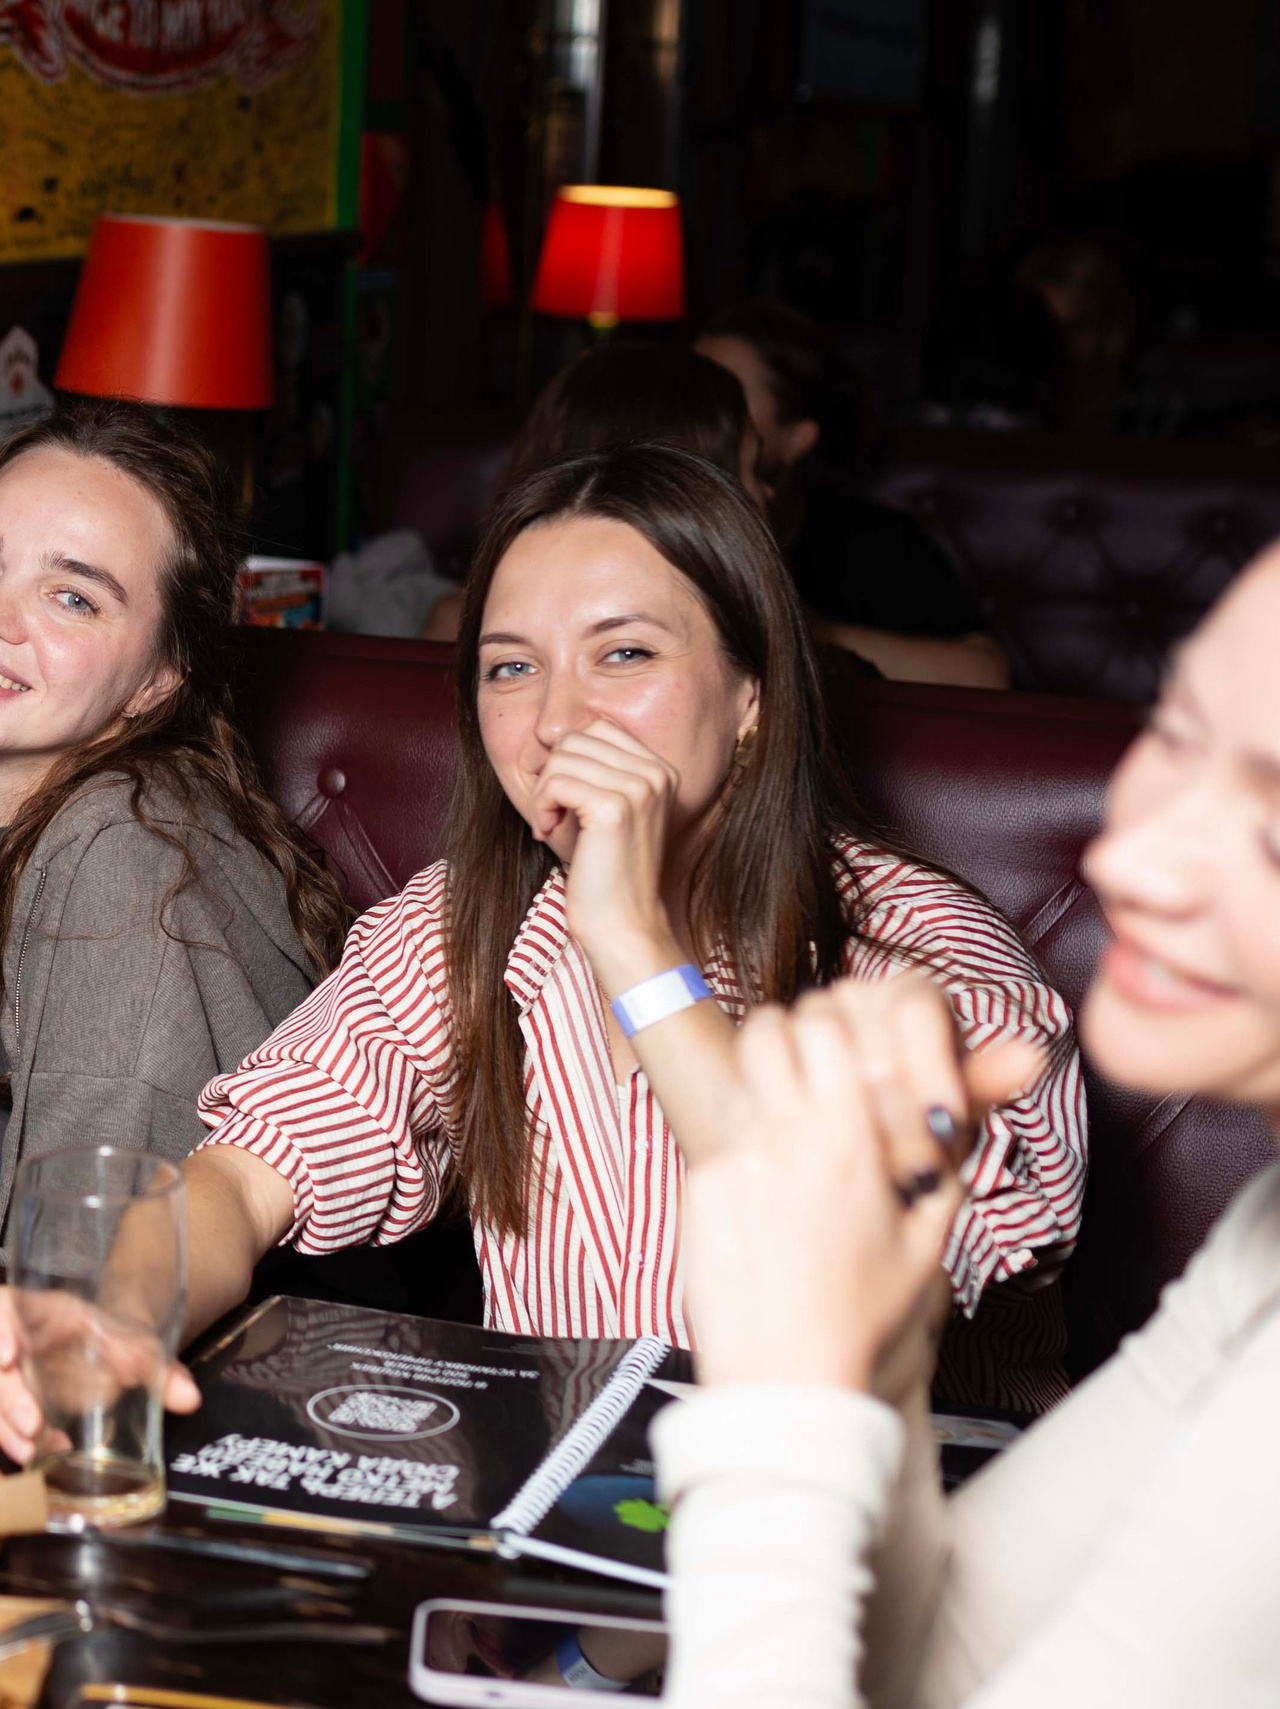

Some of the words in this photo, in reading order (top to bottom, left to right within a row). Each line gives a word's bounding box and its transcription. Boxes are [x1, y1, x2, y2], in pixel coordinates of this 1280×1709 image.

[433, 1360, 518, 1377] УСТАНОВКУ
[197, 1443, 336, 1481] НАВЕДИ
[214, 1433, 352, 1469] КАМЕРУ
[170, 1453, 231, 1478] ЖЕ
[228, 1464, 290, 1490] ТАК
[358, 1455, 459, 1481] СЮДА
[300, 1474, 421, 1508] ТЕПЕРЬ
[337, 1467, 455, 1495] МЕТКО
[432, 1492, 458, 1510] А
